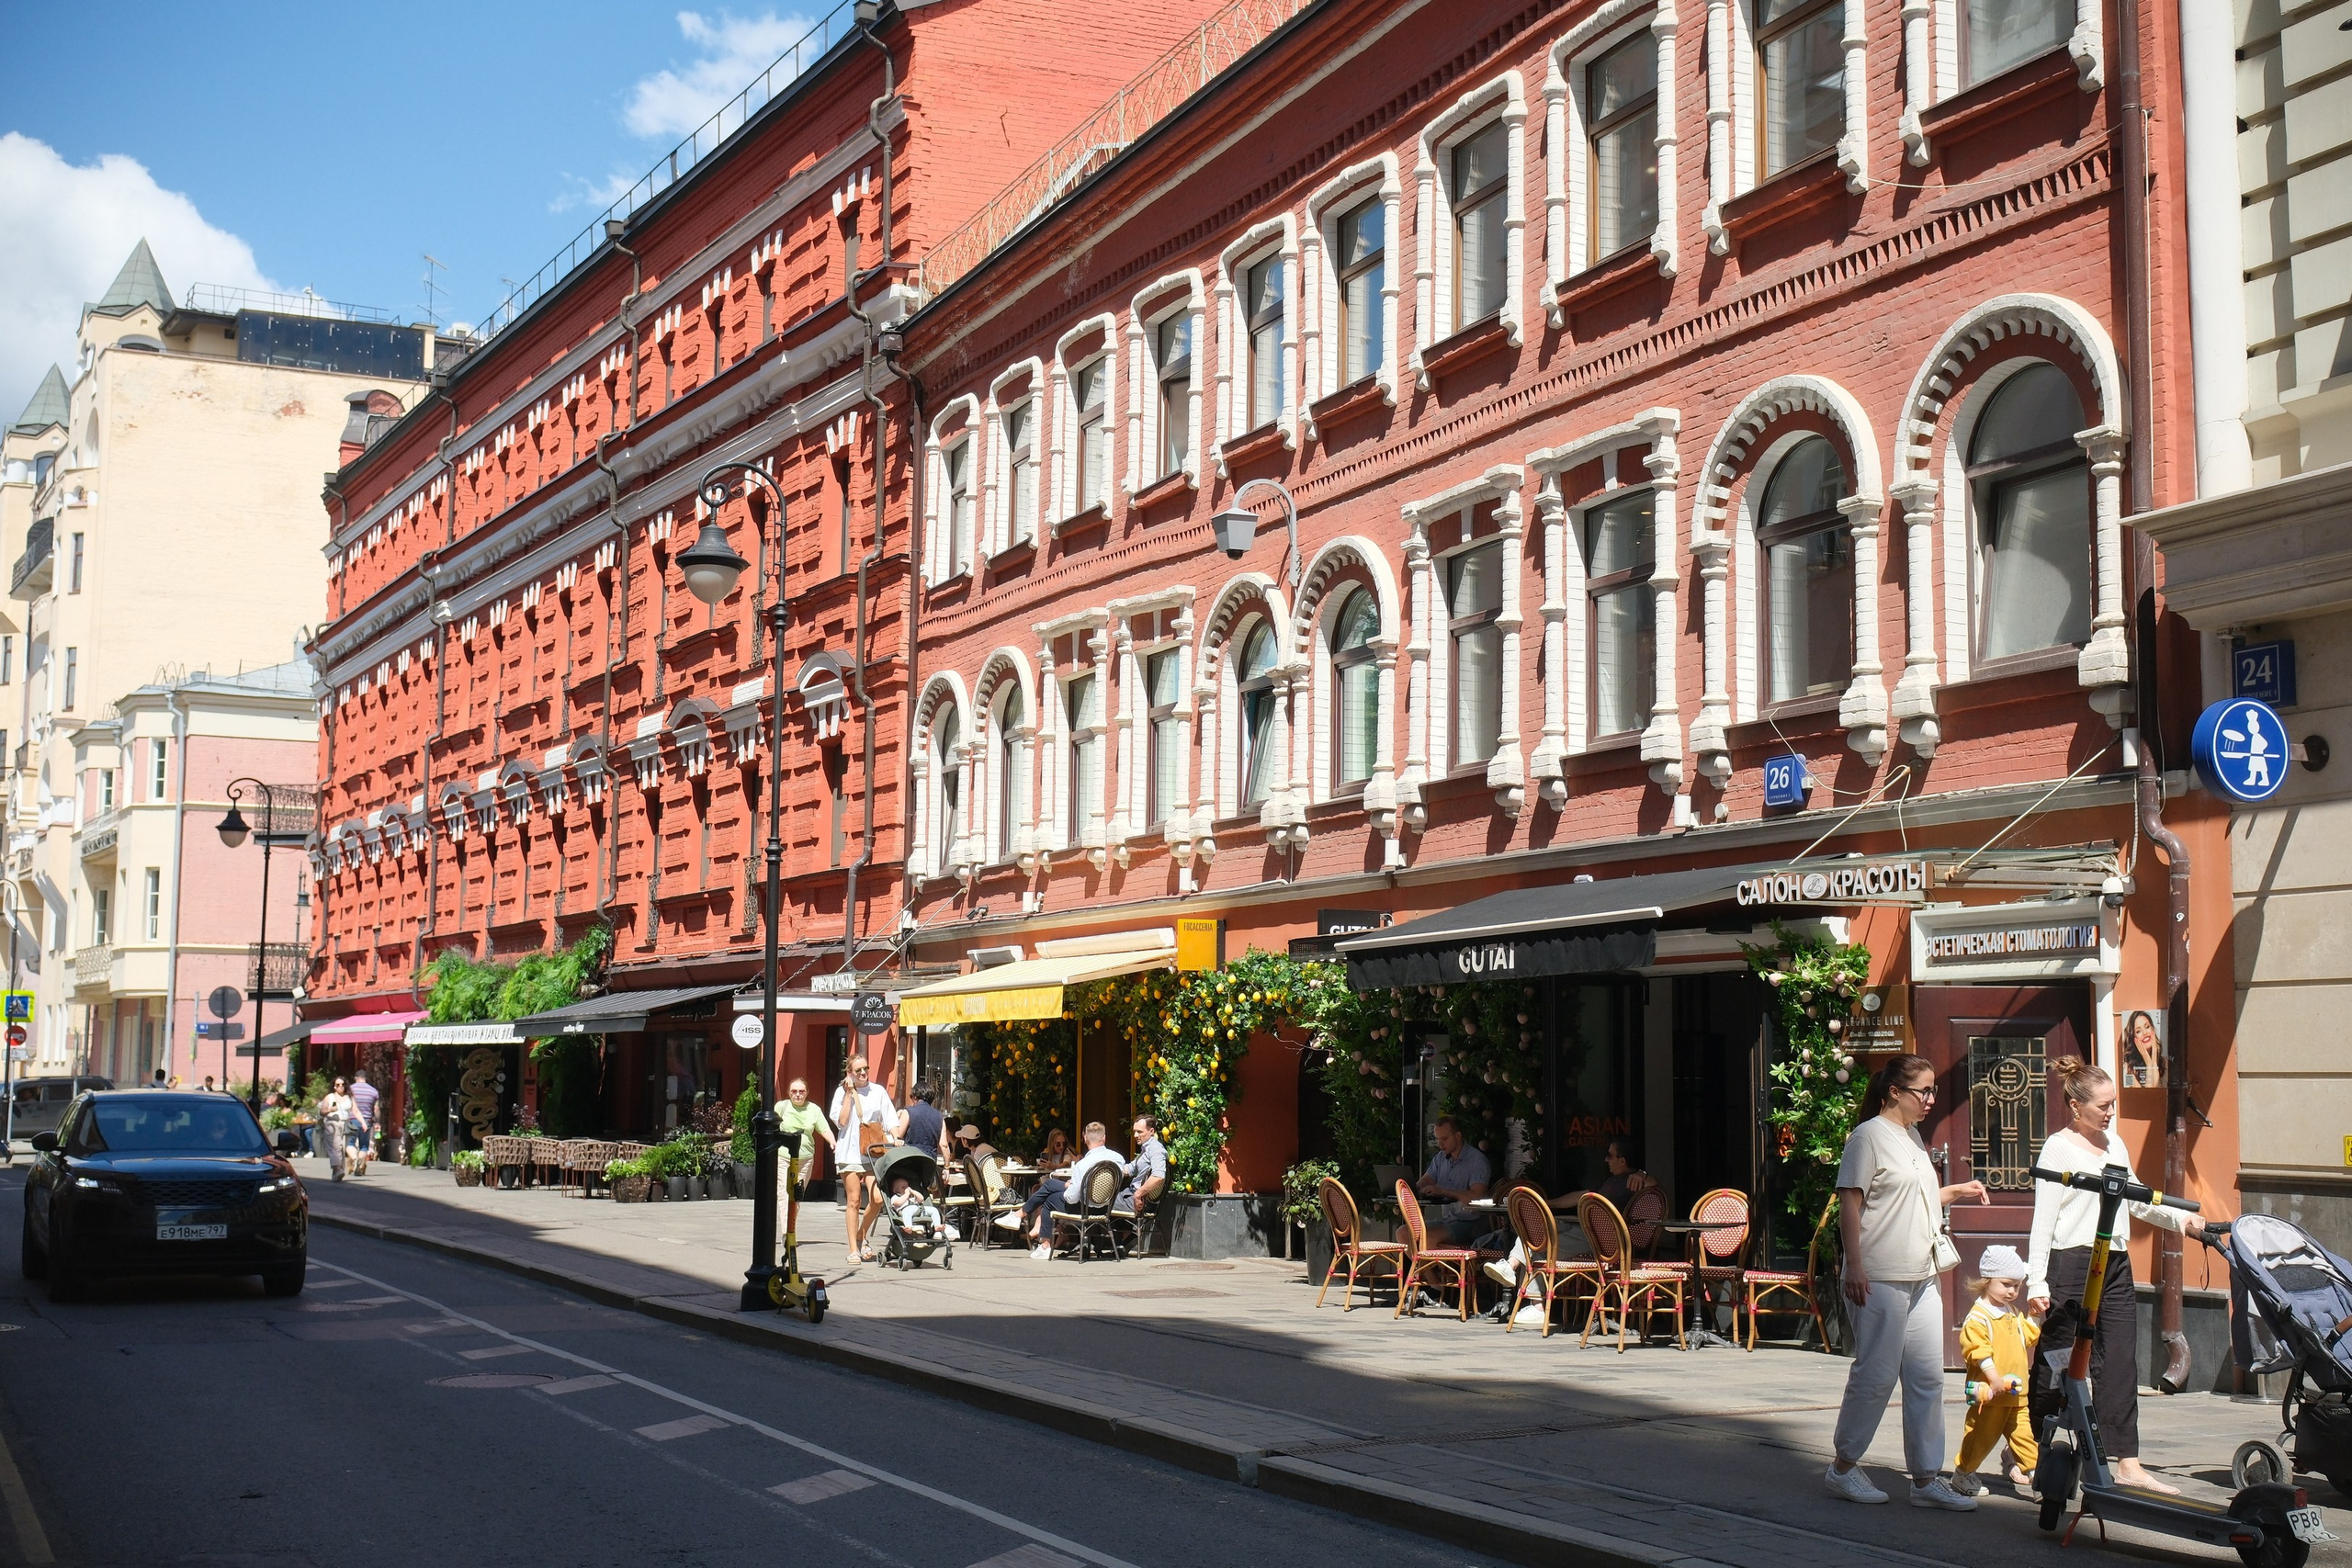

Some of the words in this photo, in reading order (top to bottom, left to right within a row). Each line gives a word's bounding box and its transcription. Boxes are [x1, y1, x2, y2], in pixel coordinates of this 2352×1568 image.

[2242, 655, 2272, 686] 24
[1770, 766, 1790, 790] 26
[1736, 874, 1801, 906] САЛОН
[1829, 862, 1927, 897] КРАСОТЫ
[1183, 922, 1214, 931] FOCACCERIA
[1926, 931, 2005, 958] ЭСТЕТИЧЕСКАЯ
[2007, 925, 2097, 953] СТОМАТОЛОГИЯ
[1459, 942, 1515, 974] GUTAI
[862, 1010, 892, 1019] КРАСОК
[1884, 1015, 1904, 1026] LINE
[1568, 1115, 1632, 1135] ASIAN
[208, 1225, 224, 1235] 797
